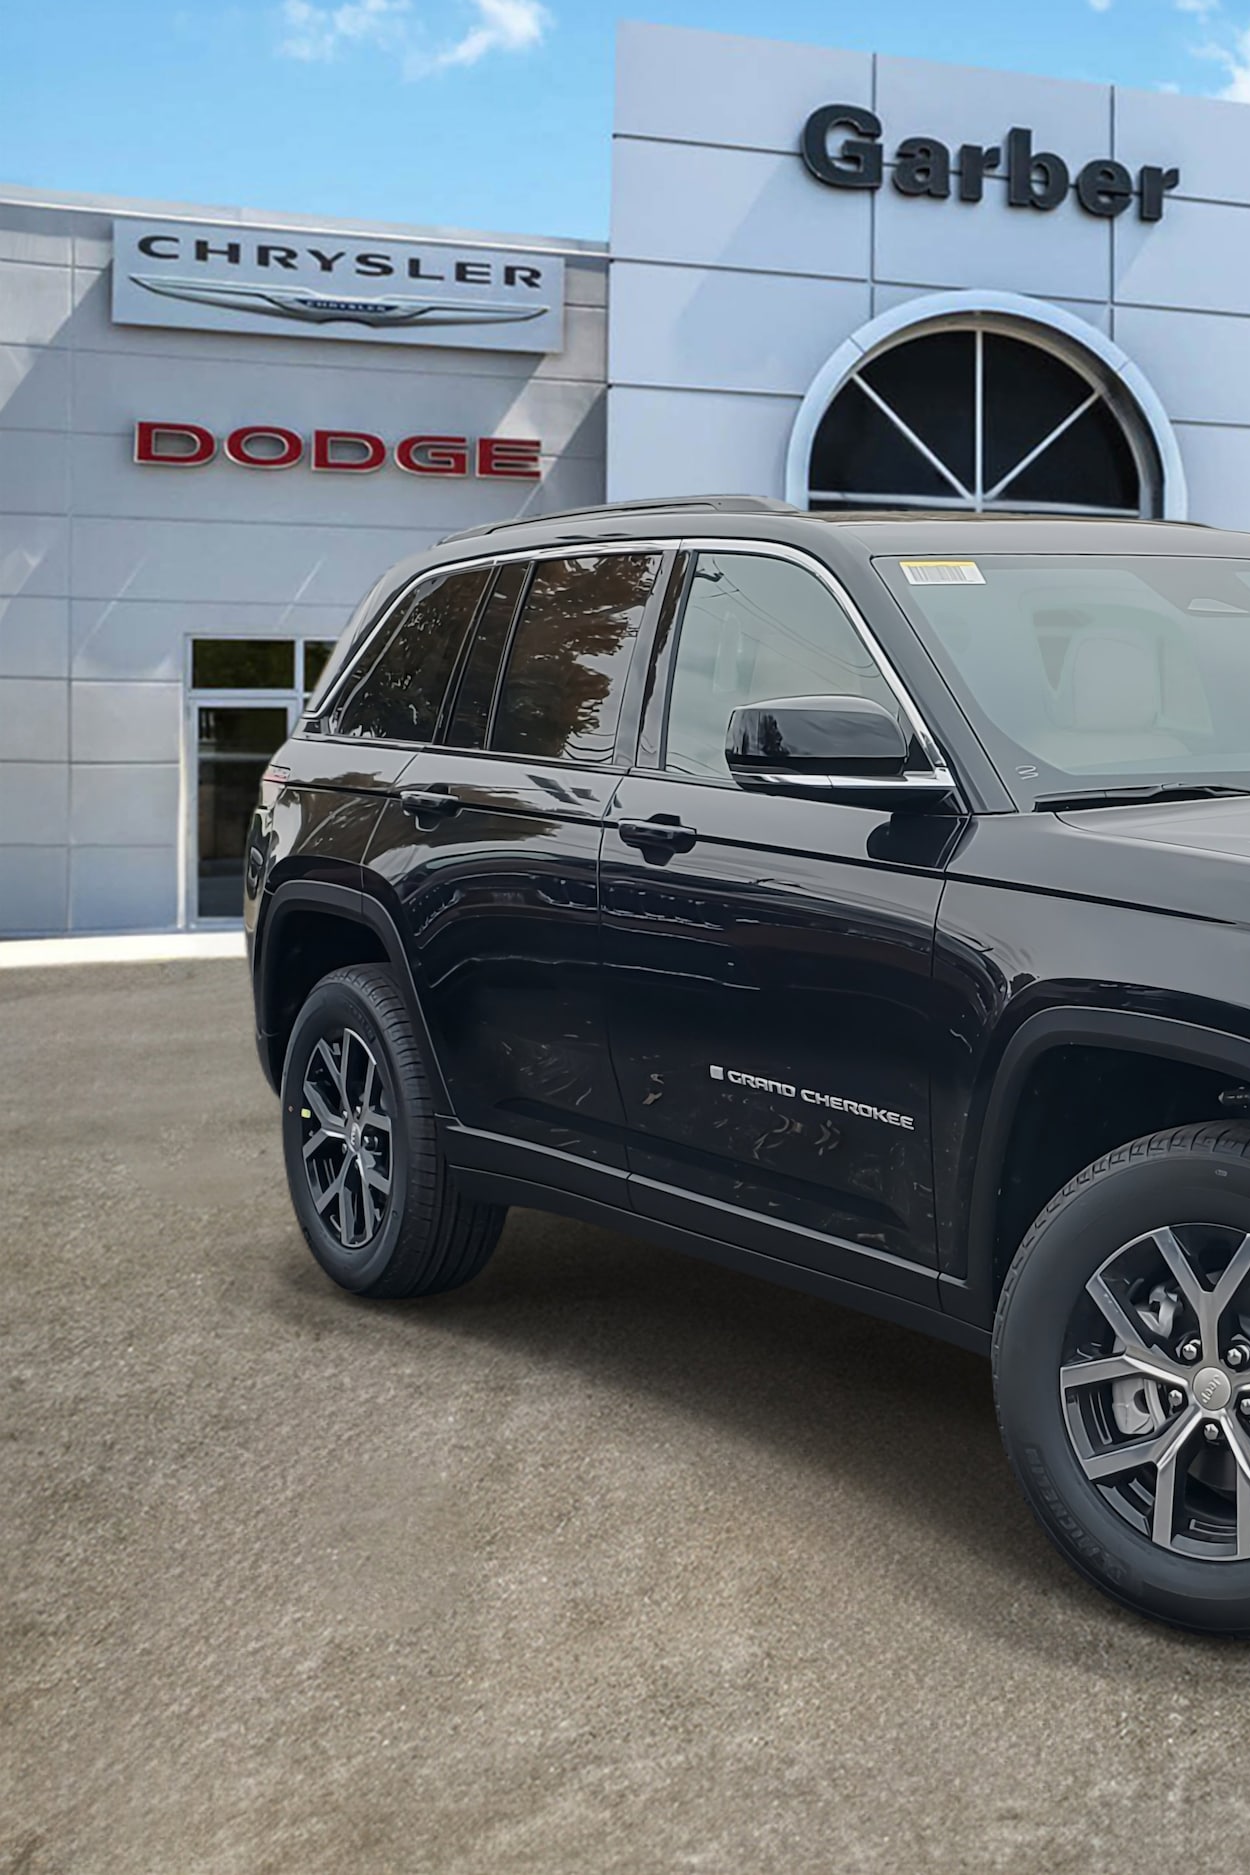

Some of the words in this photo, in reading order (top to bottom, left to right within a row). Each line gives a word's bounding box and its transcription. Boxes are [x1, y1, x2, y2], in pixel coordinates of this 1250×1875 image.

[800, 104, 1180, 222] Garber
[139, 236, 541, 288] CHRYSLER
[134, 421, 542, 480] DODGE
[727, 1070, 796, 1098] GRAND
[800, 1089, 915, 1131] CHEROKEE
[1201, 1374, 1221, 1403] Jeep
